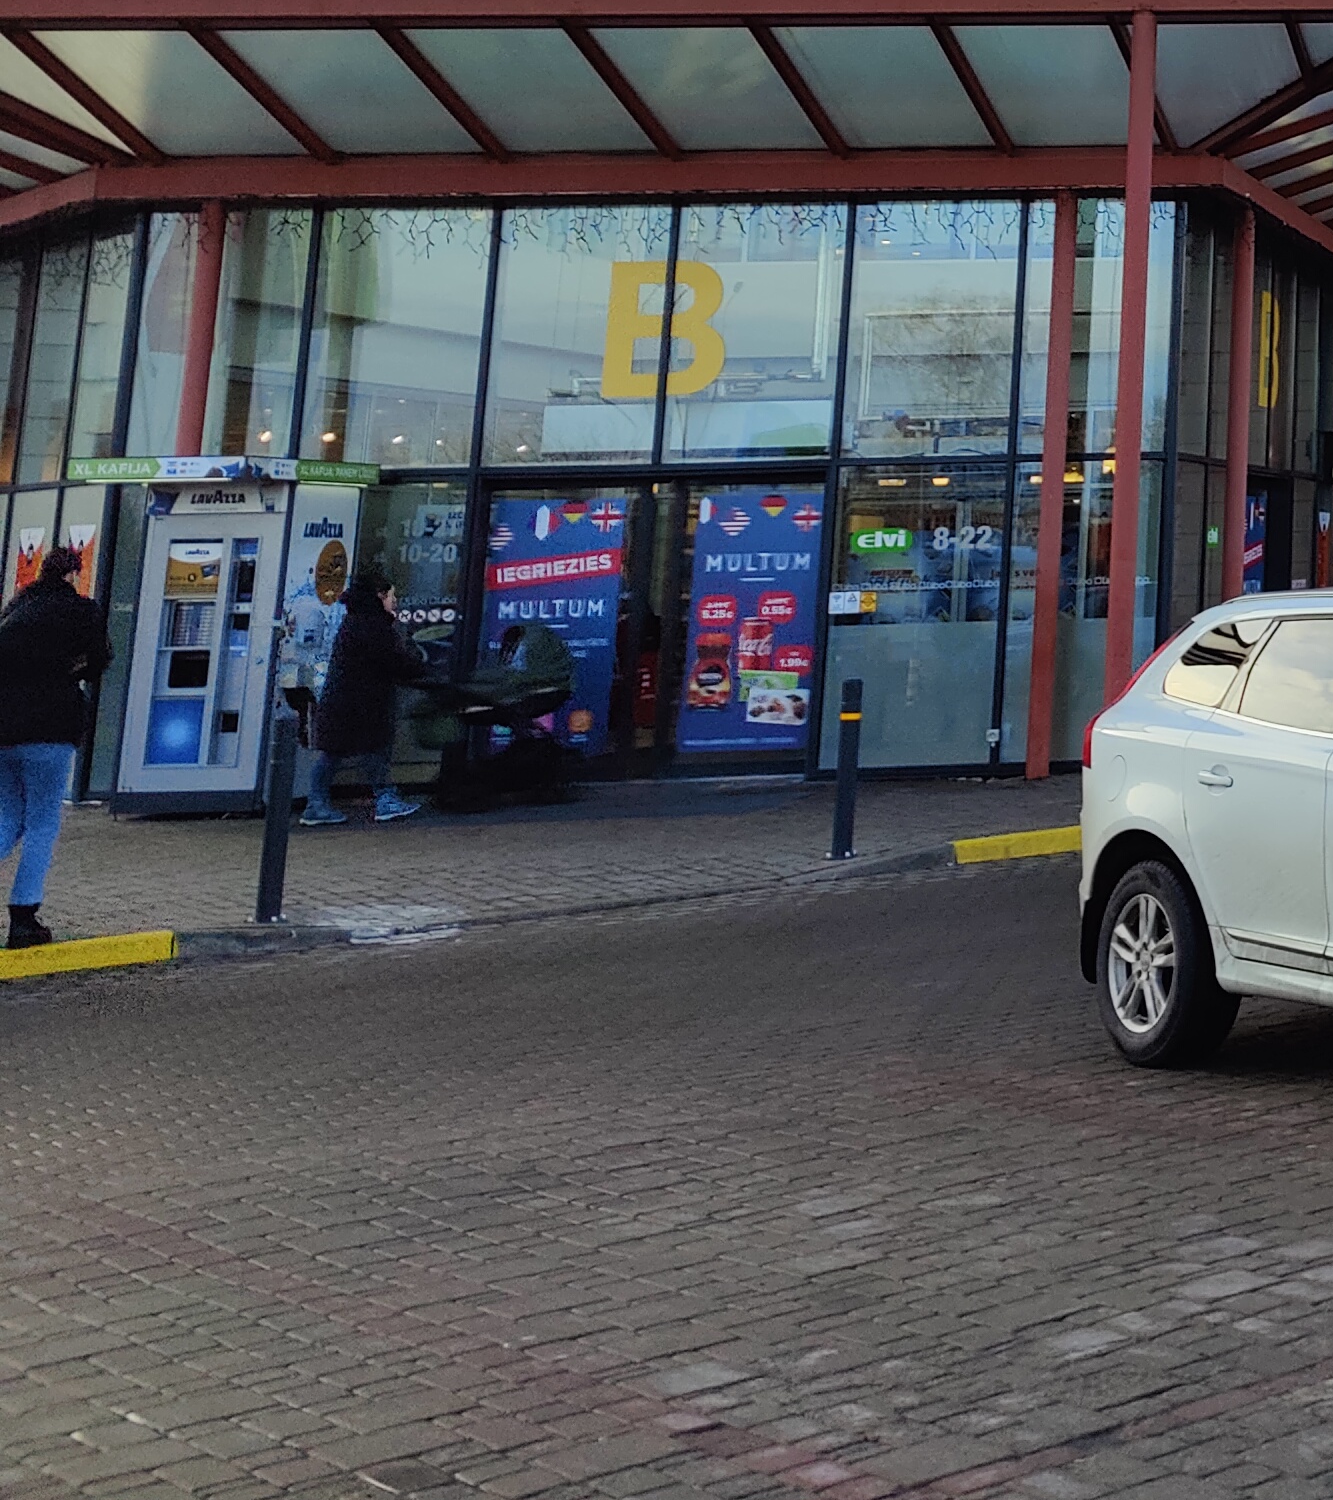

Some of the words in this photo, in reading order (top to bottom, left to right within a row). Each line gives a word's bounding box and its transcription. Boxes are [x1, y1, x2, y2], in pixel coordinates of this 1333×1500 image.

[602, 260, 725, 398] B
[74, 463, 92, 476] XL
[97, 462, 151, 475] KAFIJA
[190, 489, 246, 505] LAVAZZA
[303, 517, 344, 538] LAVAZZA
[932, 525, 992, 550] 8-22
[400, 543, 457, 563] 10-20
[705, 553, 811, 573] MULTUM
[496, 553, 612, 584] IEGRIEZIES
[497, 599, 605, 620] MULTUM
